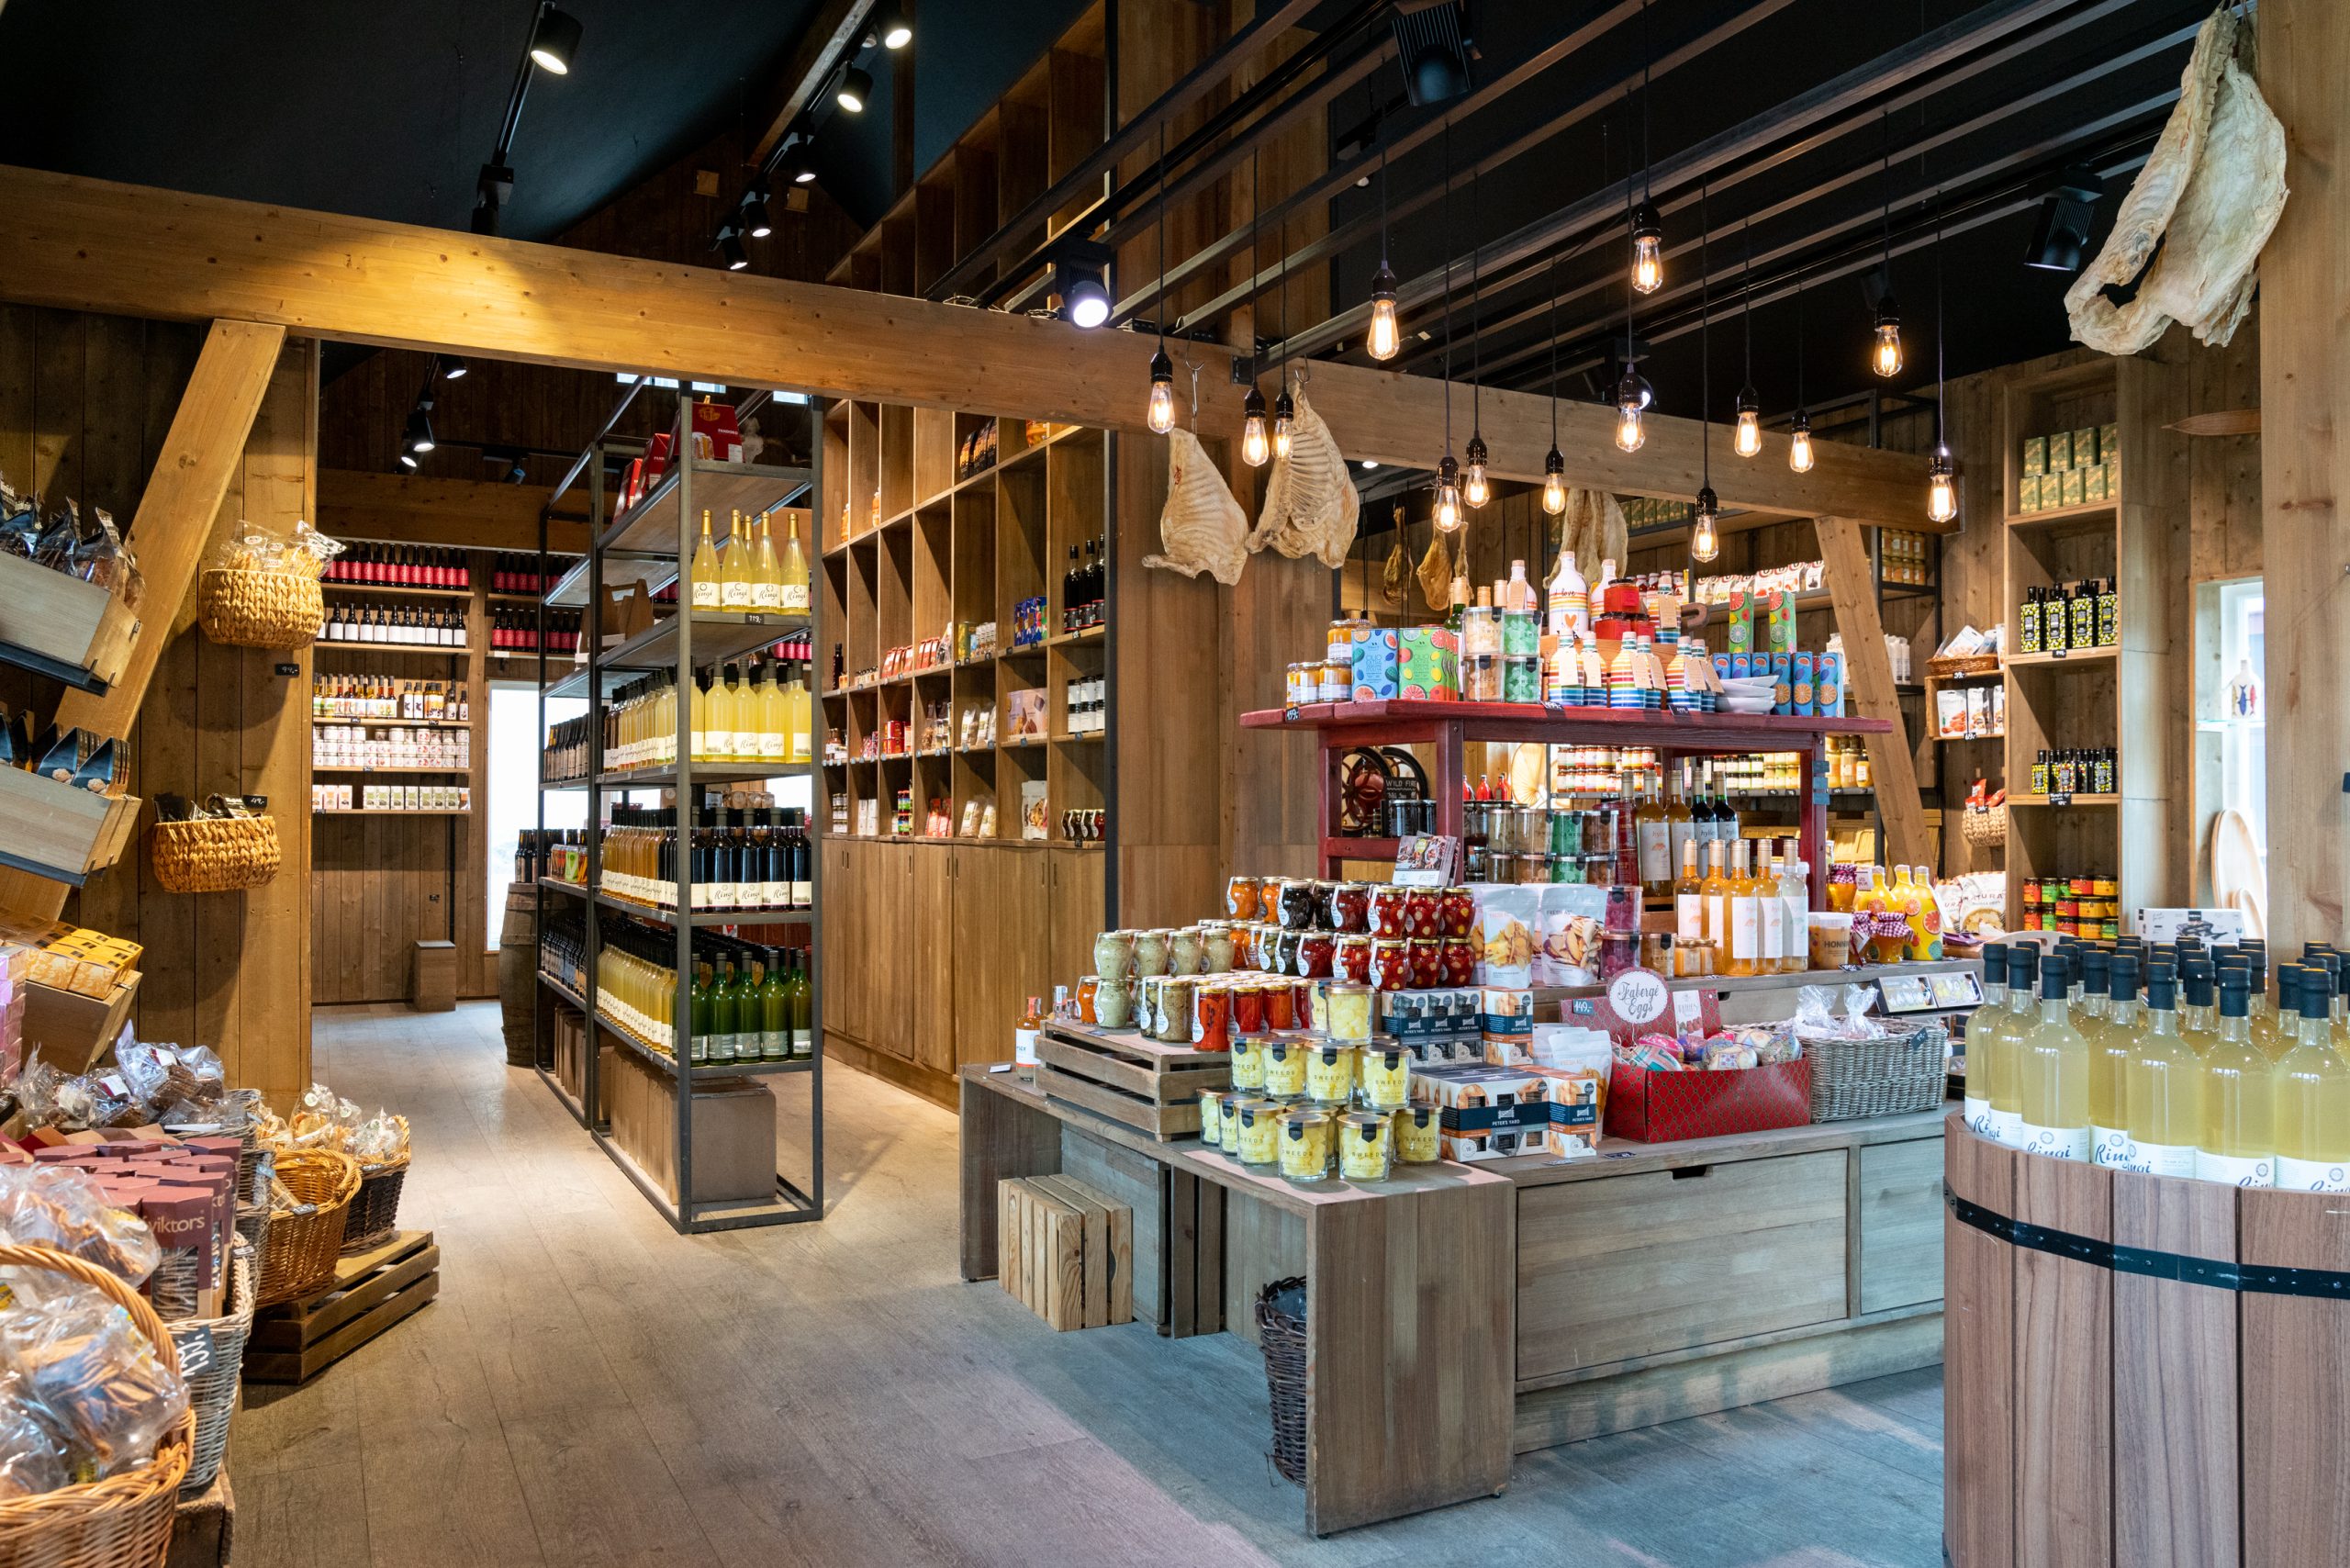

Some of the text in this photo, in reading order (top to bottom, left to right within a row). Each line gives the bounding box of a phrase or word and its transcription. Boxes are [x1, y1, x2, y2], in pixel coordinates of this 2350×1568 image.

[1404, 779, 1417, 788] FIRE
[1617, 980, 1660, 1001] Fabergé
[1626, 997, 1653, 1020] Eggs
